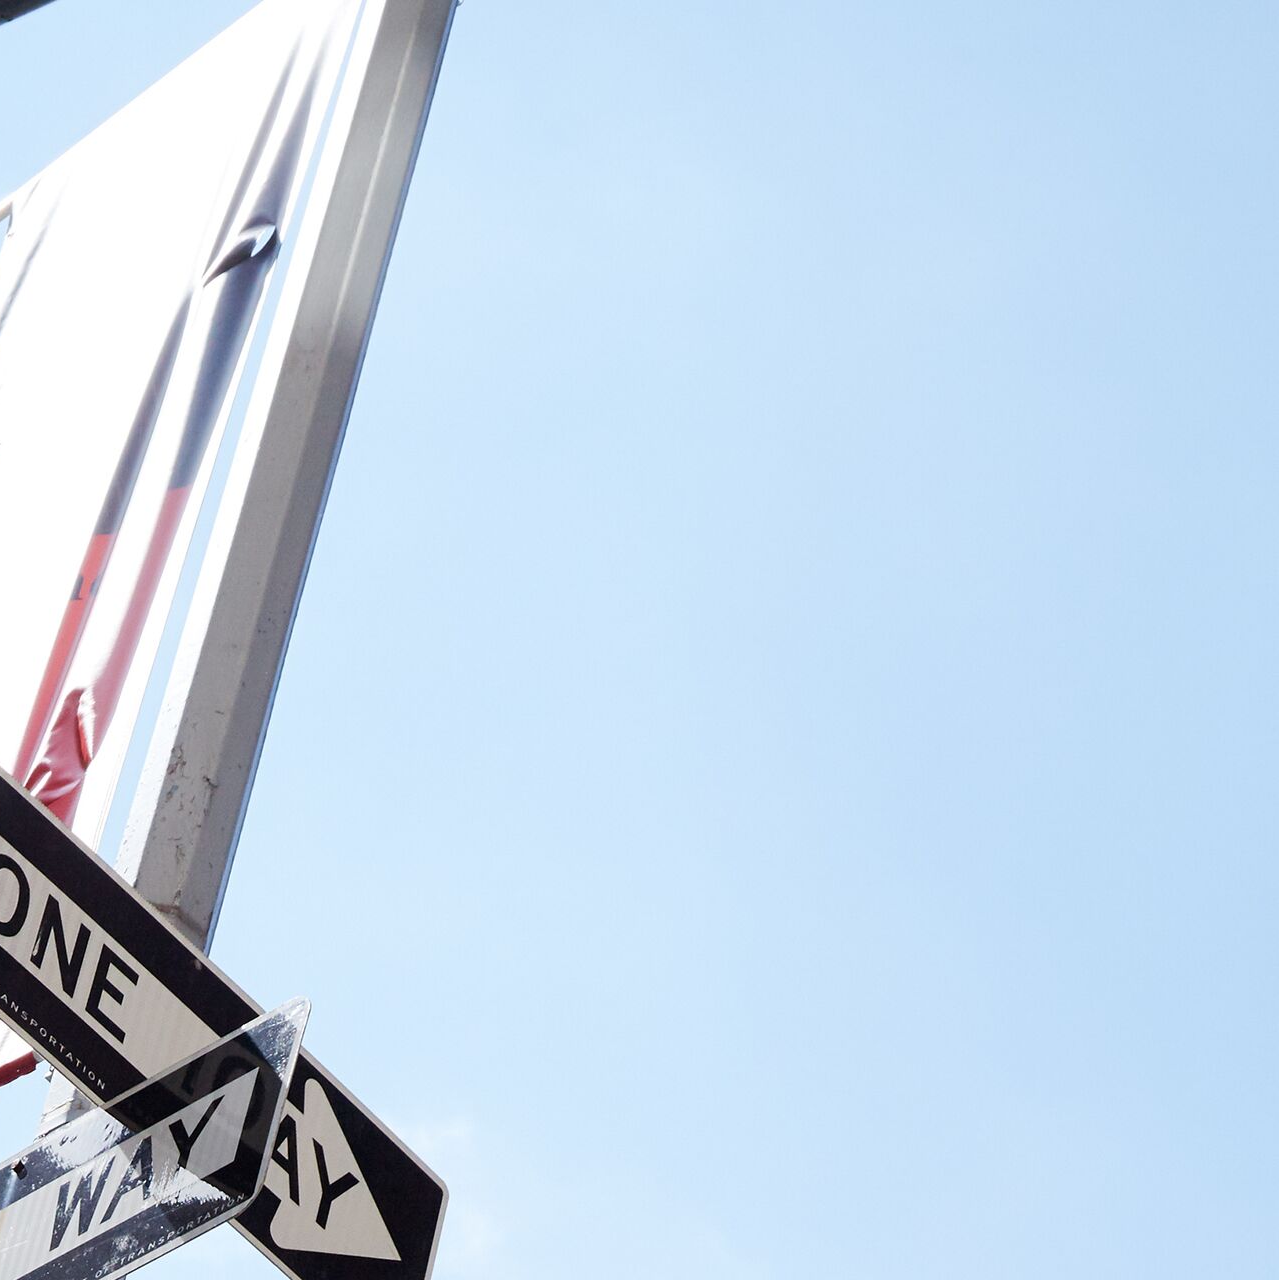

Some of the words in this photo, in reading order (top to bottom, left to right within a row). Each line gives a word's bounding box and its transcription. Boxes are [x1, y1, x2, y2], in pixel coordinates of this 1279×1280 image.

[49, 1095, 226, 1251] WAY
[119, 1193, 246, 1265] TRANSPORTATION
[270, 1113, 360, 1230] AY
